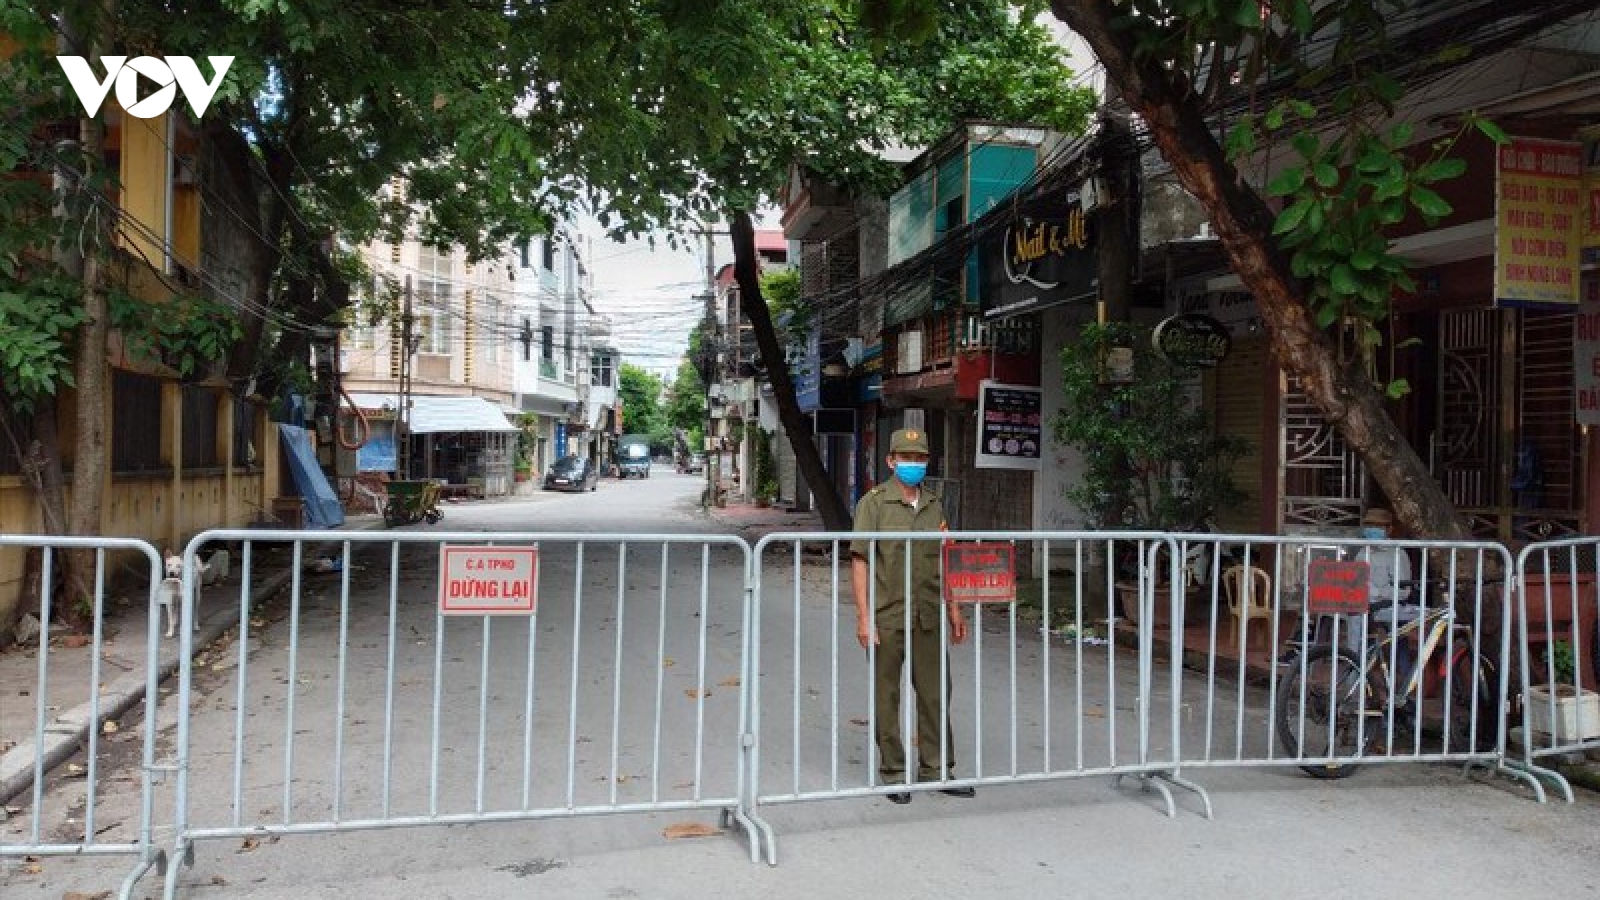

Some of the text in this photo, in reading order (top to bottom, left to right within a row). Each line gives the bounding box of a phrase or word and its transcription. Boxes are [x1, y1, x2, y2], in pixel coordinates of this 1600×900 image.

[1013, 221, 1047, 265] Nail
[1049, 225, 1066, 257] &
[450, 576, 528, 602] DỪNG LẠI
